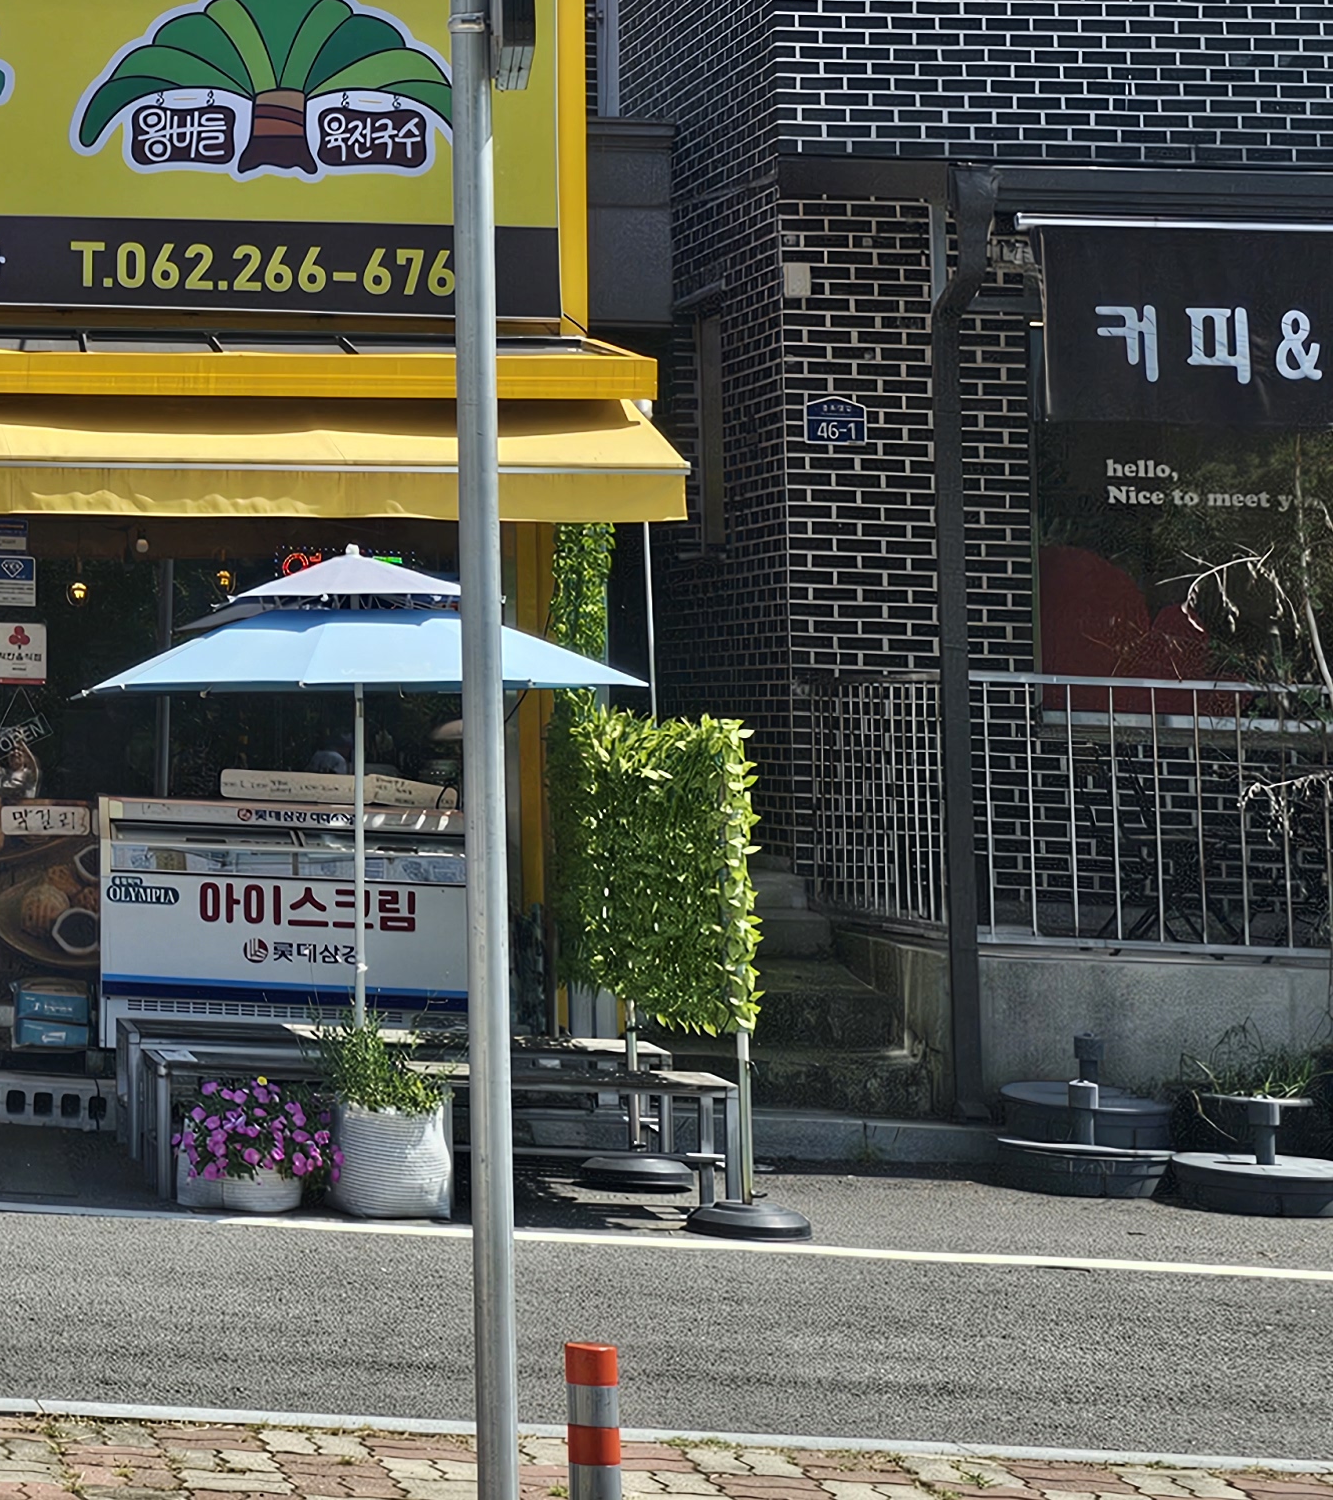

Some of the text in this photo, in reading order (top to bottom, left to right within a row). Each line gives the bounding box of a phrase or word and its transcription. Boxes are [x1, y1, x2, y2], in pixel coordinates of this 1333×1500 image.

[137, 109, 227, 164] 왕버들
[323, 112, 421, 161] 육전국수
[71, 242, 454, 297] T.062.266-676
[817, 422, 856, 440] 46-1
[1106, 459, 1179, 481] hello,
[1107, 486, 1165, 505] Nice
[1172, 490, 1200, 506] to
[1207, 491, 1271, 508] meet
[13, 807, 76, 831] 막걸리
[109, 885, 176, 904] OLYMPIA
[199, 882, 417, 932] 아이스크림
